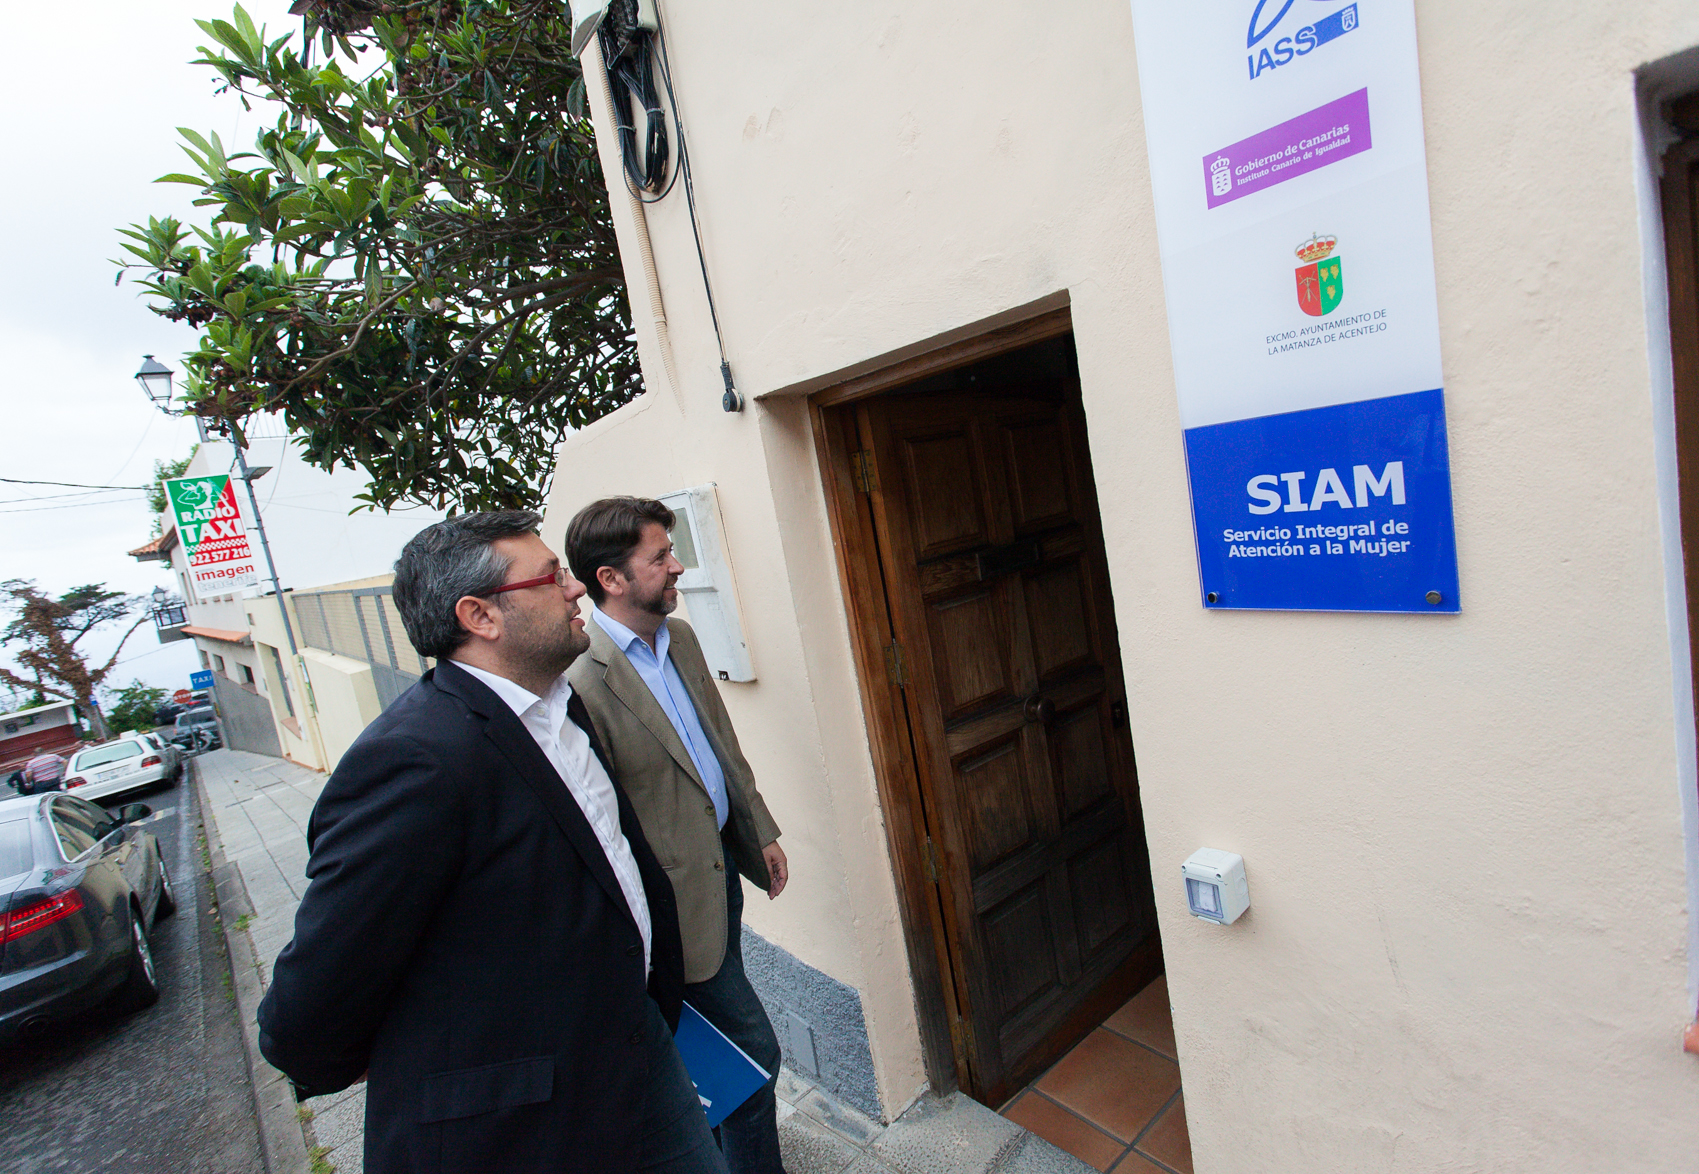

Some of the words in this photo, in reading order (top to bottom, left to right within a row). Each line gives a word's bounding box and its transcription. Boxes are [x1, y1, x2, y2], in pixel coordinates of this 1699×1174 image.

[1247, 25, 1316, 81] IASS
[1235, 147, 1284, 176] Gobierno
[1284, 144, 1298, 157] de
[1299, 122, 1350, 151] Canarias
[1236, 167, 1270, 186] Instituto
[1271, 154, 1301, 173] Canario
[1302, 149, 1313, 160] de
[1315, 134, 1351, 157] Igualdad
[1266, 330, 1298, 344] EXCMO.
[1300, 312, 1372, 337] AYUNTAMIENTO
[1373, 308, 1387, 319] DE
[1267, 346, 1279, 356] LA
[1280, 336, 1322, 353] MATANZA
[1324, 334, 1336, 344] DE
[1338, 322, 1387, 341] ACENTEJO
[1246, 460, 1406, 515] SIAM
[180, 506, 235, 522] RADIO
[180, 518, 246, 543] TAXI
[1223, 526, 1291, 542] Servicio
[1296, 520, 1376, 541] Integral
[1381, 519, 1409, 535] de
[189, 553, 211, 565] 922
[211, 550, 230, 562] 577
[231, 547, 251, 559] 216
[1228, 540, 1304, 558] Atención
[1309, 543, 1321, 555] a
[1326, 540, 1343, 555] la
[1349, 538, 1410, 557] Mujer
[195, 564, 254, 582] imagen
[192, 675, 212, 684] TAXI
